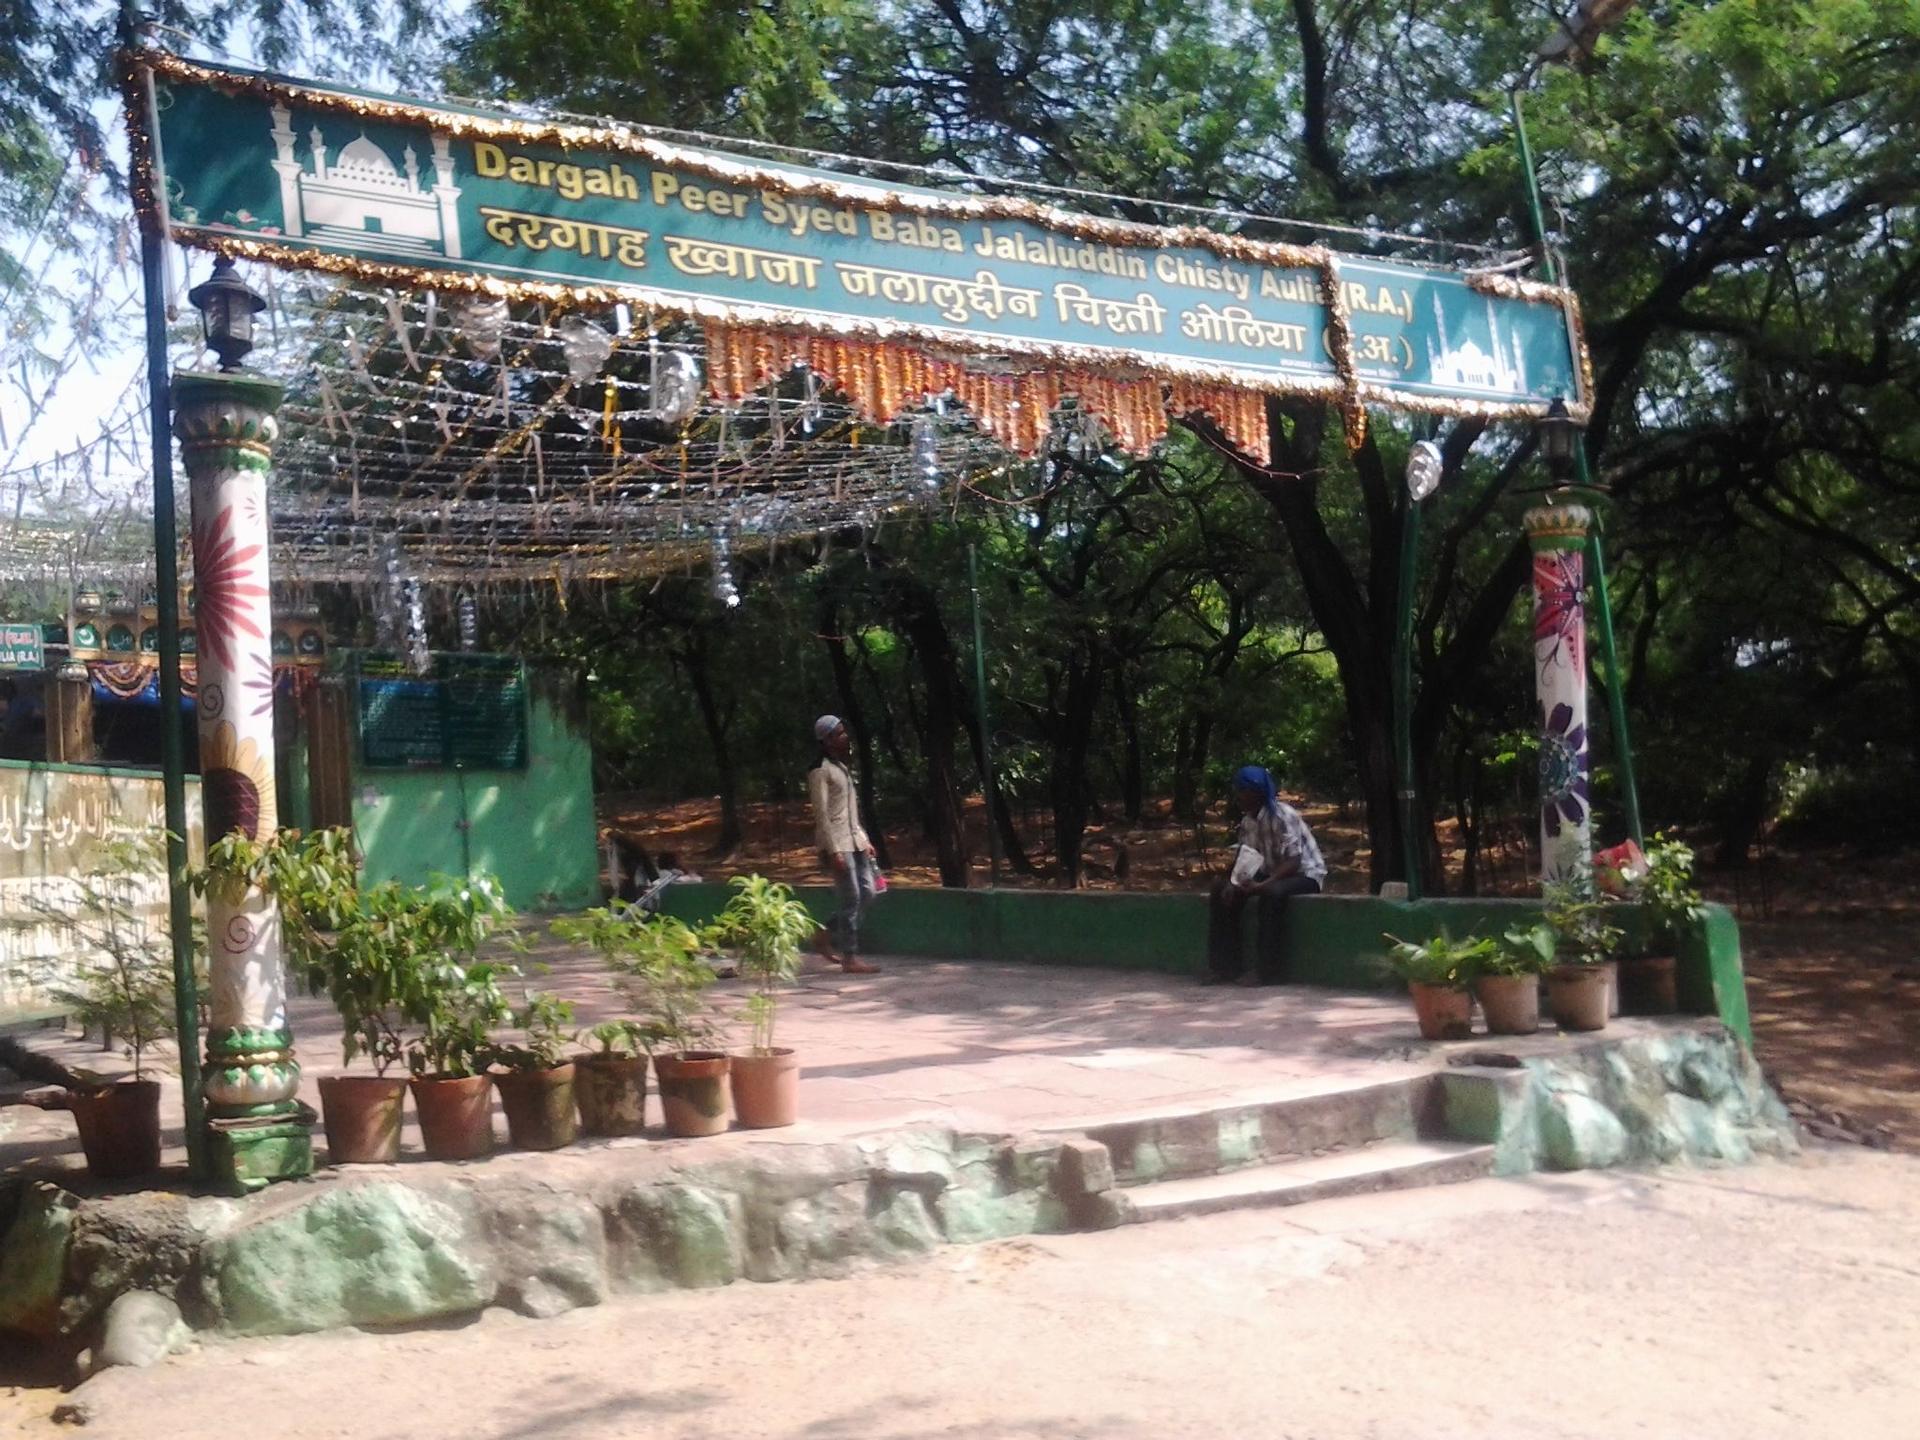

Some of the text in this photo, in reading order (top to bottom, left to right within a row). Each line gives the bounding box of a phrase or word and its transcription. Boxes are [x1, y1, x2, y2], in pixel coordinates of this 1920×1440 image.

[474, 142, 639, 201] Dargah
[651, 171, 750, 219] Peer
[761, 189, 858, 236] Syed
[868, 208, 964, 253] Baba
[973, 226, 1148, 280] Jalaluddin
[1155, 254, 1249, 301] Chisty
[1337, 281, 1413, 323] (R.A.)
[480, 206, 649, 267] दरगाह
[664, 235, 823, 289] ख्वाजा
[834, 262, 1042, 323] जलालुद्दीन
